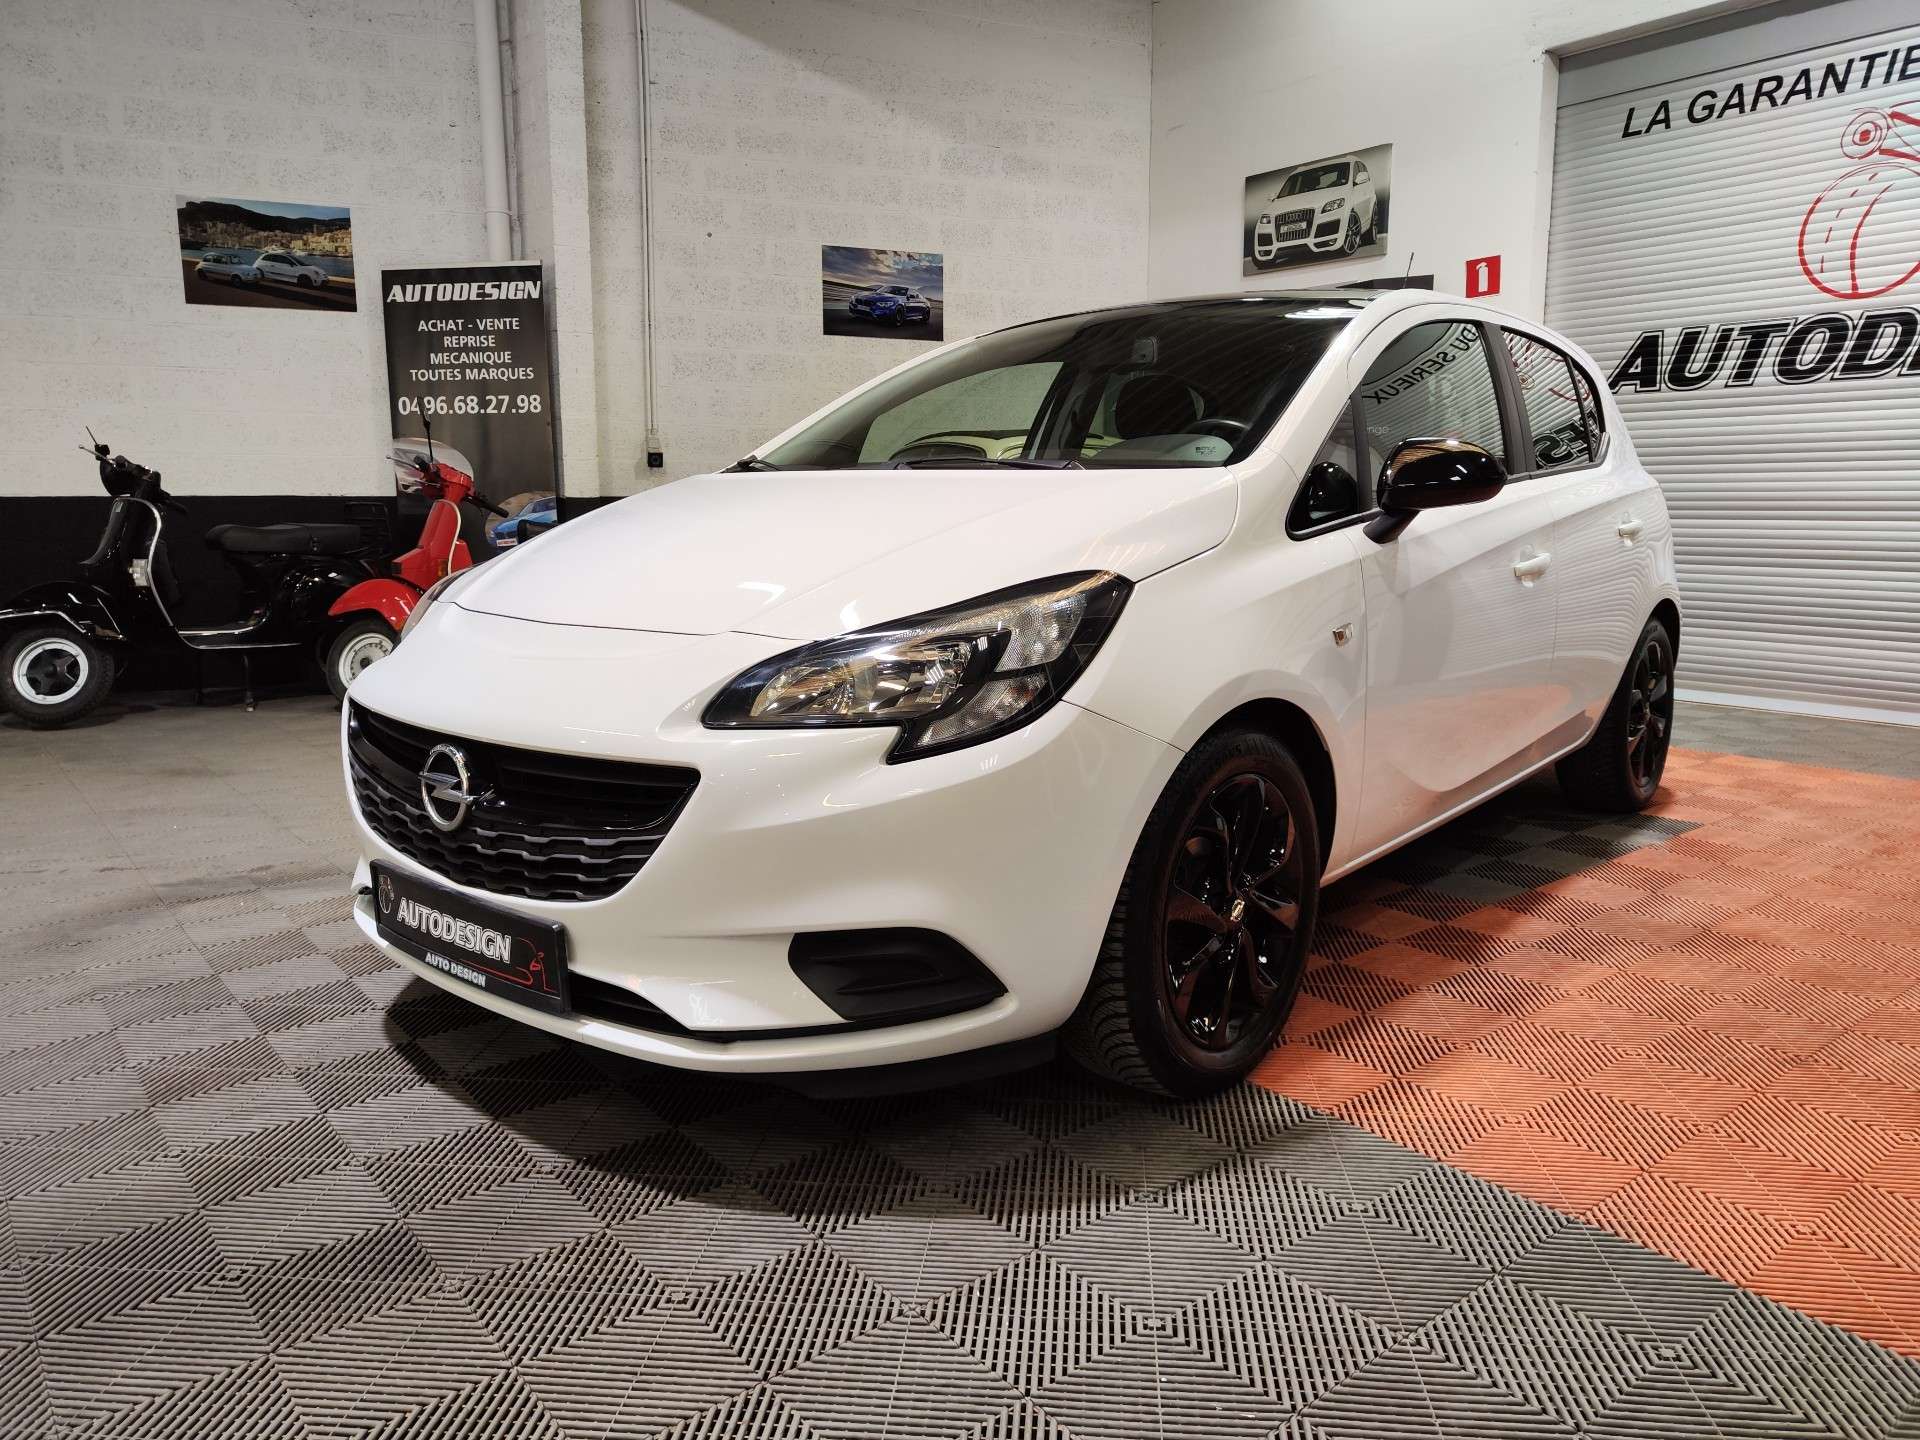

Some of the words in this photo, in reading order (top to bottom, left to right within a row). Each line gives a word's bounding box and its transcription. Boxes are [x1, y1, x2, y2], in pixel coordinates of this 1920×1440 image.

[1621, 100, 1671, 139] LA
[1687, 44, 1920, 124] GARANTIE
[386, 280, 541, 303] AUTODESIGN
[417, 319, 464, 332] ACHAT
[476, 318, 520, 331] VENTE
[443, 335, 496, 348] REPRISE
[1607, 307, 1920, 394] AUTOD
[430, 351, 512, 366] MECANIQUE
[410, 368, 461, 382] TOUTES
[465, 367, 535, 382] MARQUES
[397, 897, 511, 964] AUTODESIGN
[425, 952, 450, 972] AUTO
[450, 963, 486, 988] DESIGN
